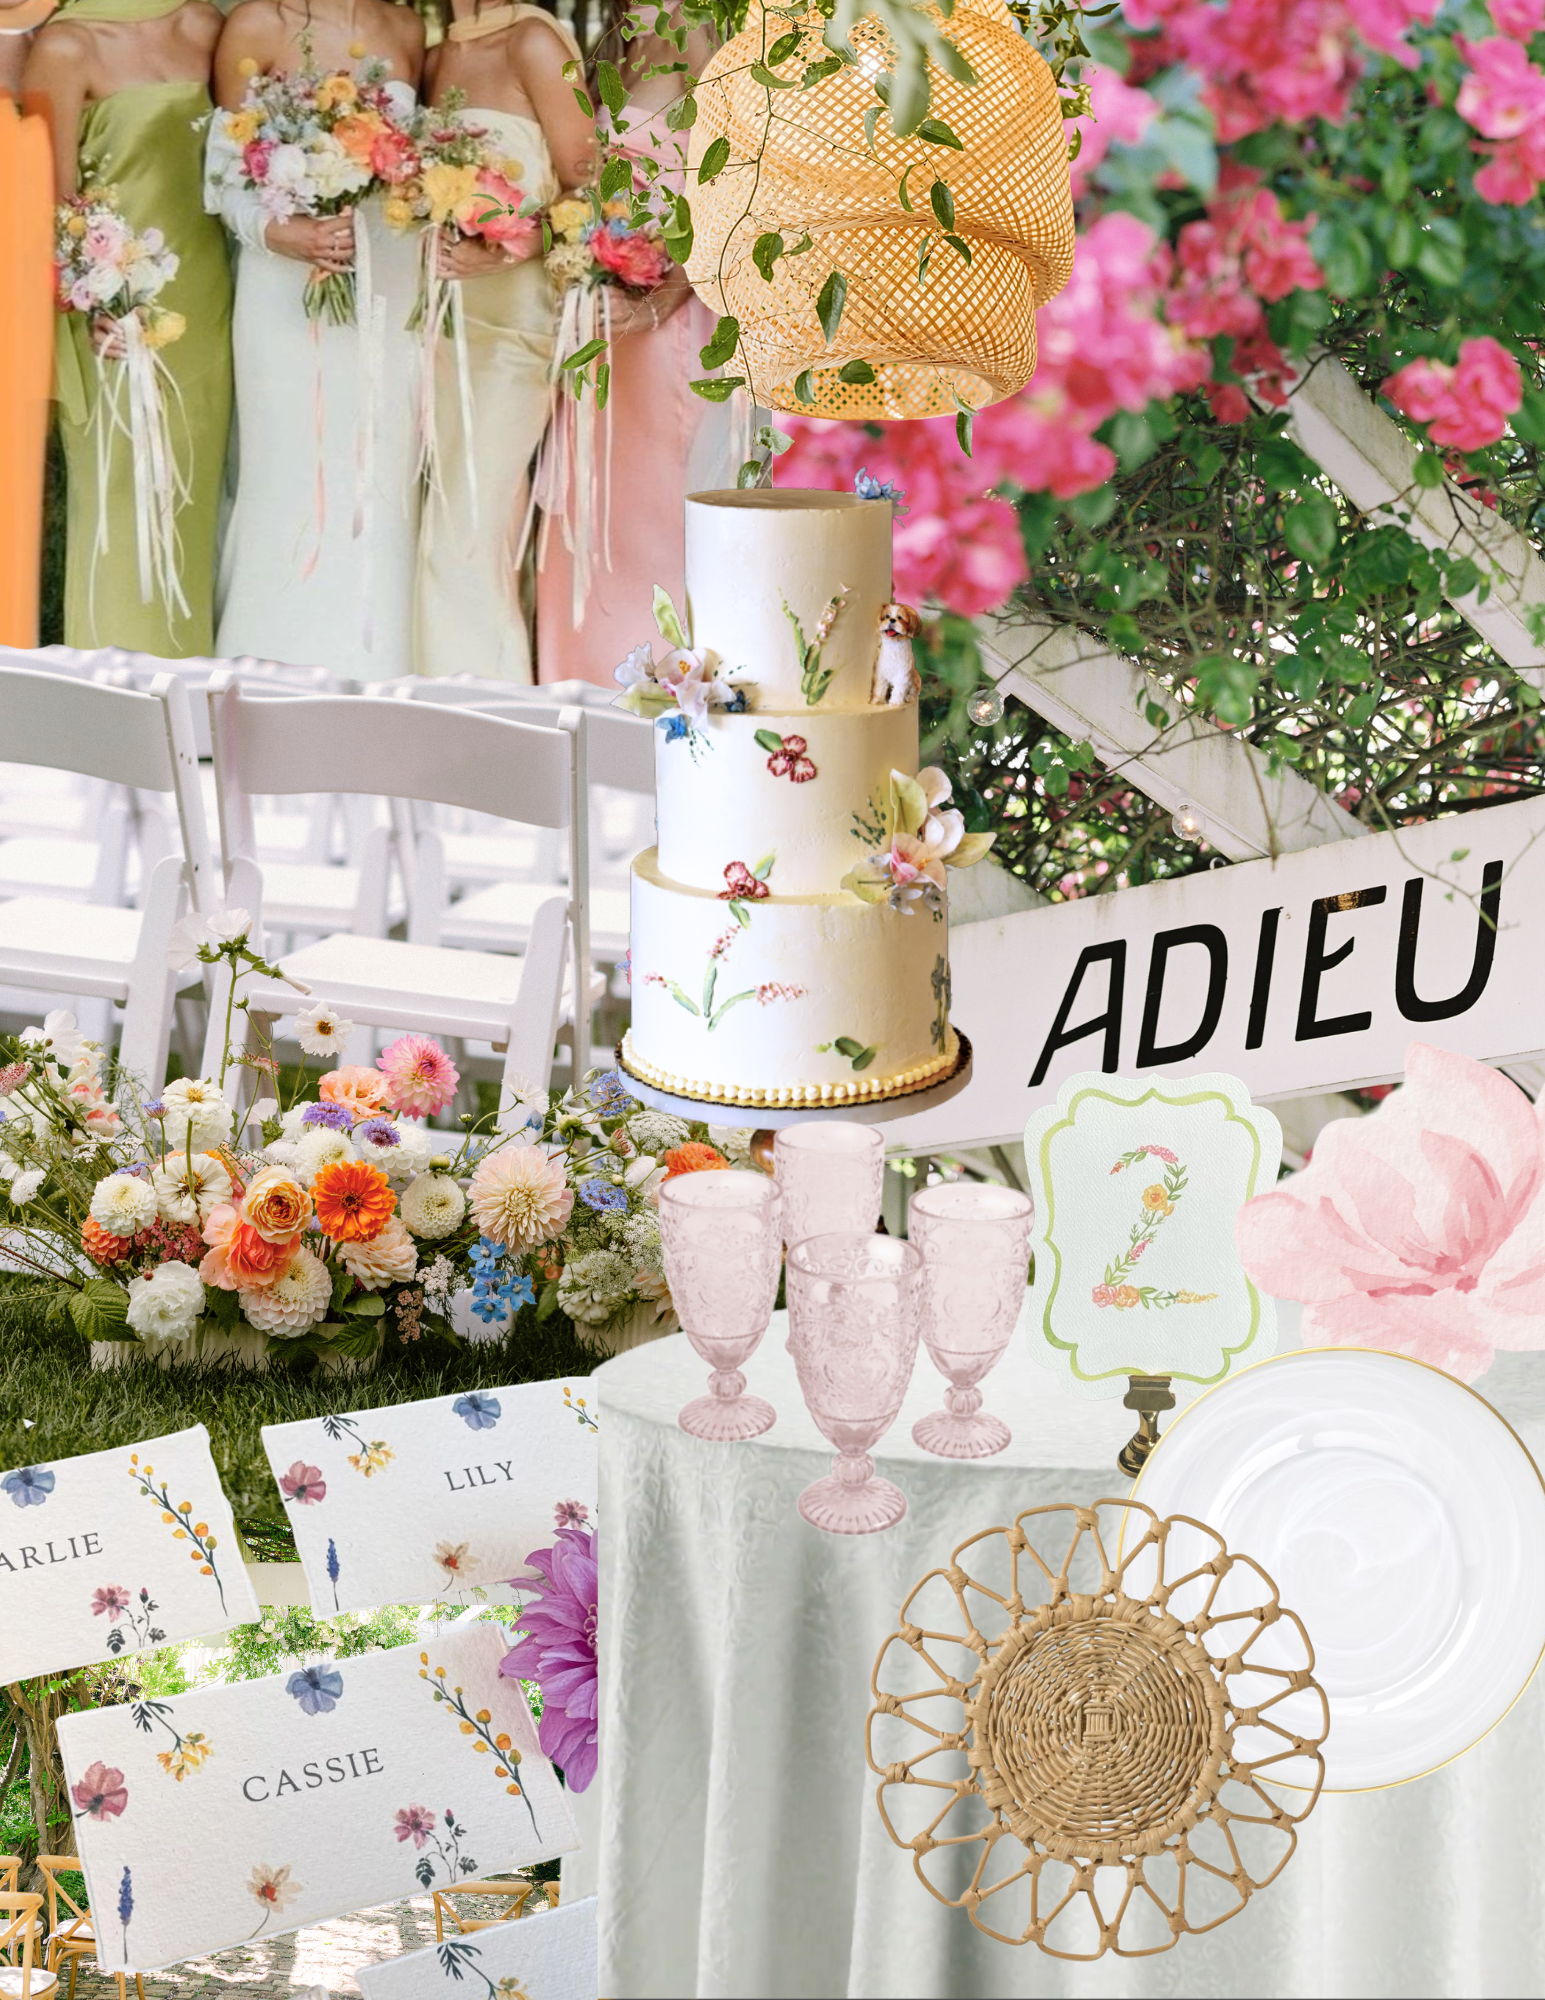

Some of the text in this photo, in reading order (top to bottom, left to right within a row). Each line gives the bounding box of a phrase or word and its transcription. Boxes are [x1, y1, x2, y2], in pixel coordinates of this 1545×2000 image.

[1027, 859, 1504, 1088] ADIEU
[1091, 1144, 1219, 1311] 2
[443, 1460, 514, 1491] LILY
[242, 1748, 384, 1802] CASSIE
